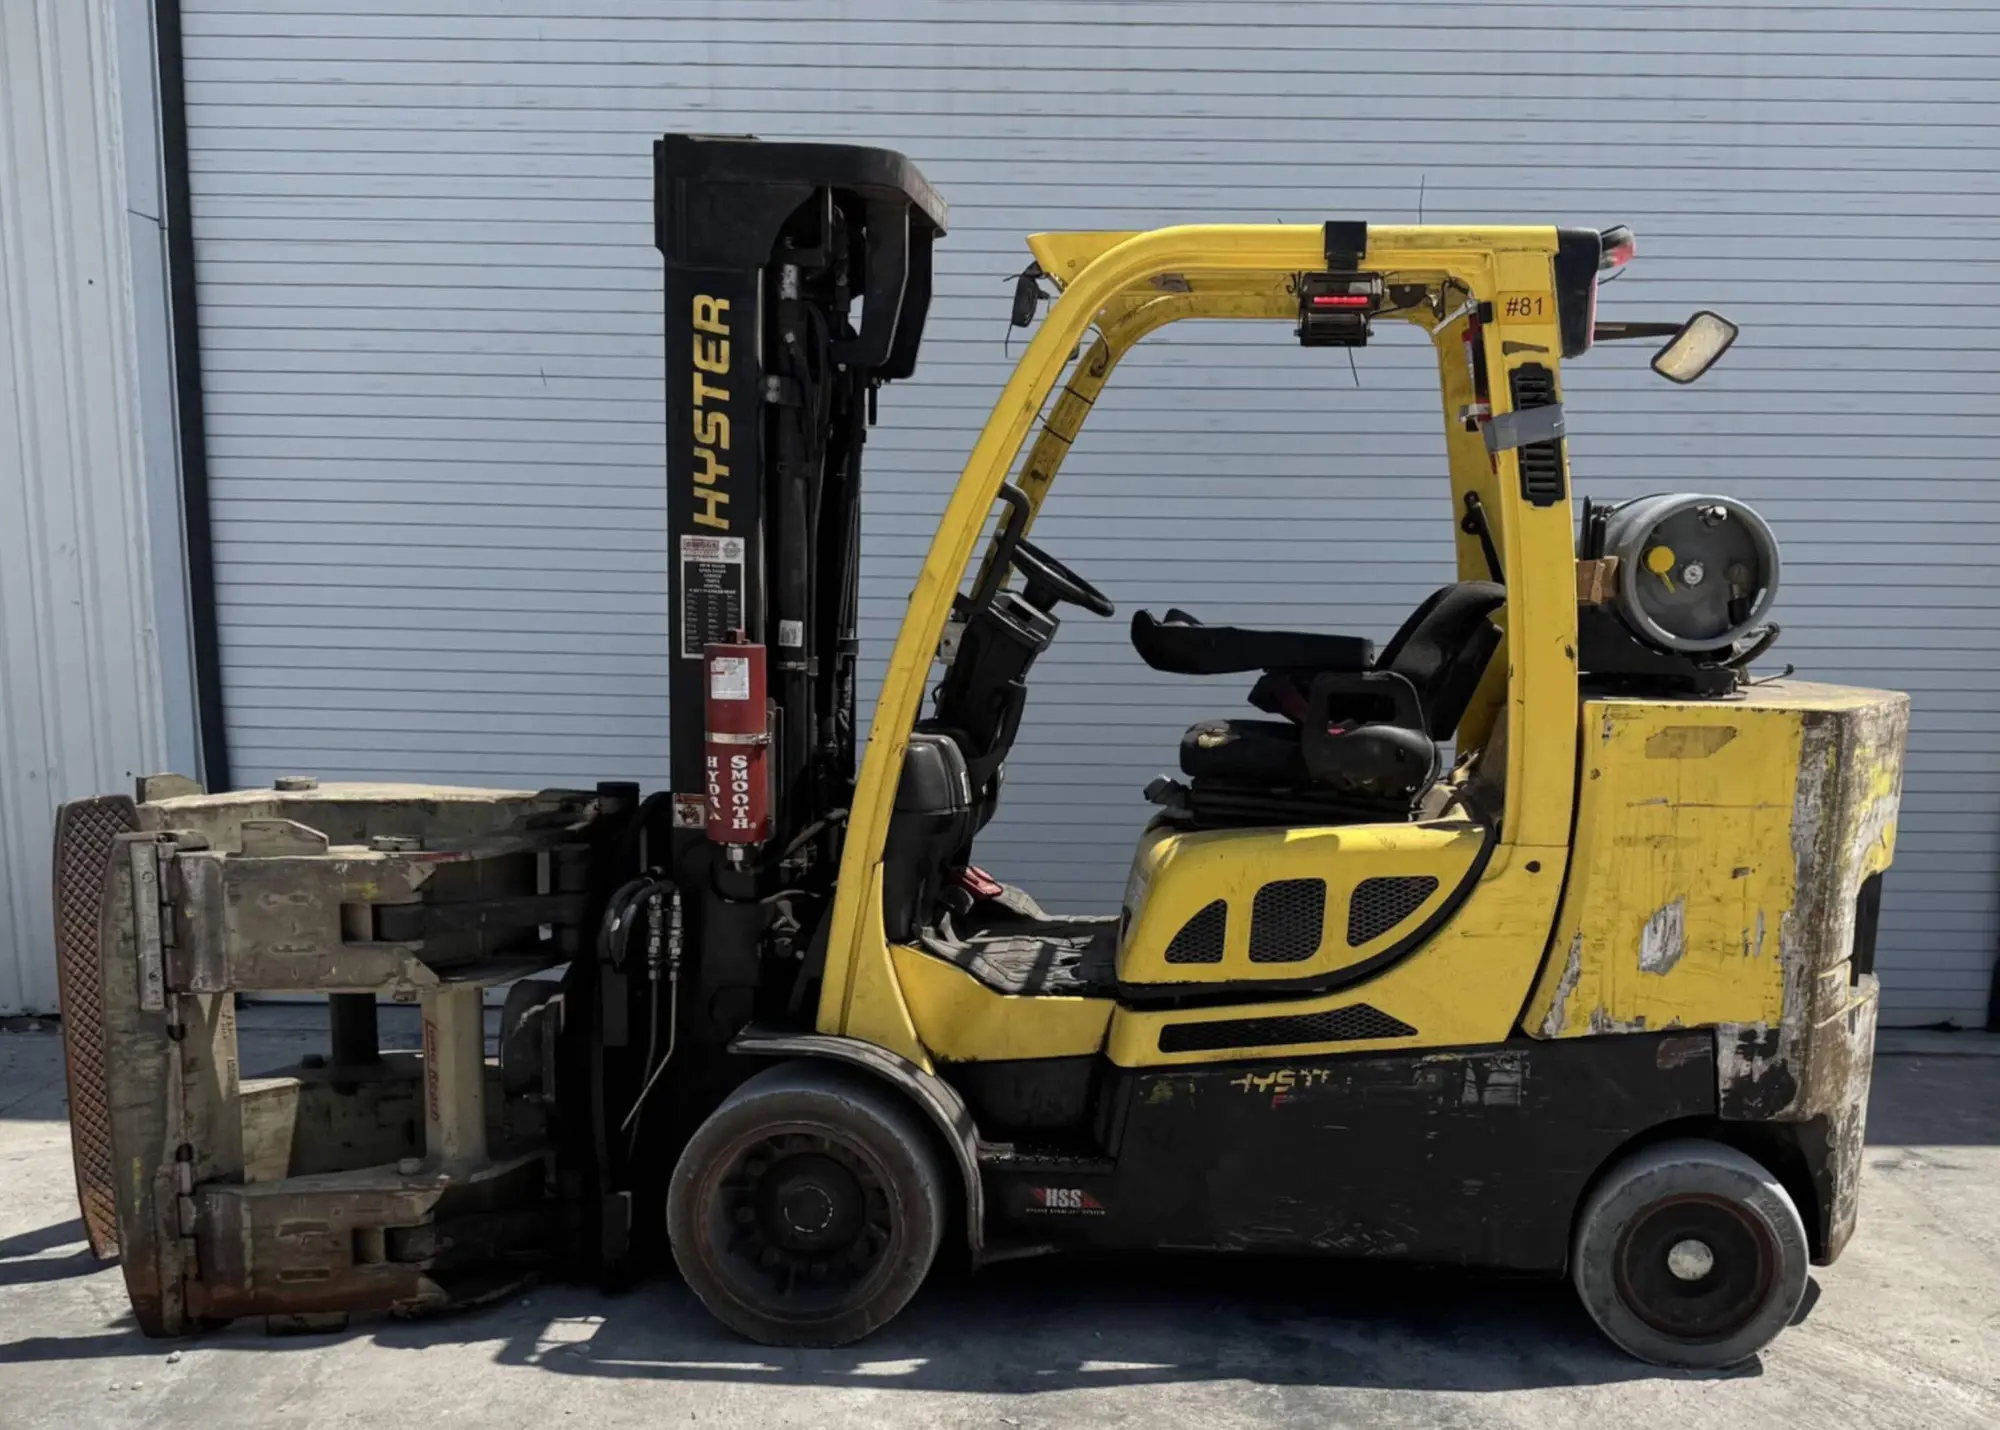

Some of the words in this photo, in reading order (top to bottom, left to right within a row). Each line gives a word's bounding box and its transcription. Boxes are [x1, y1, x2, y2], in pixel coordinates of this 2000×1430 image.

[1505, 296, 1543, 317] #81
[692, 294, 731, 530] HYSTER
[707, 755, 722, 821] HYDRA
[1045, 1187, 1082, 1208] HSS
